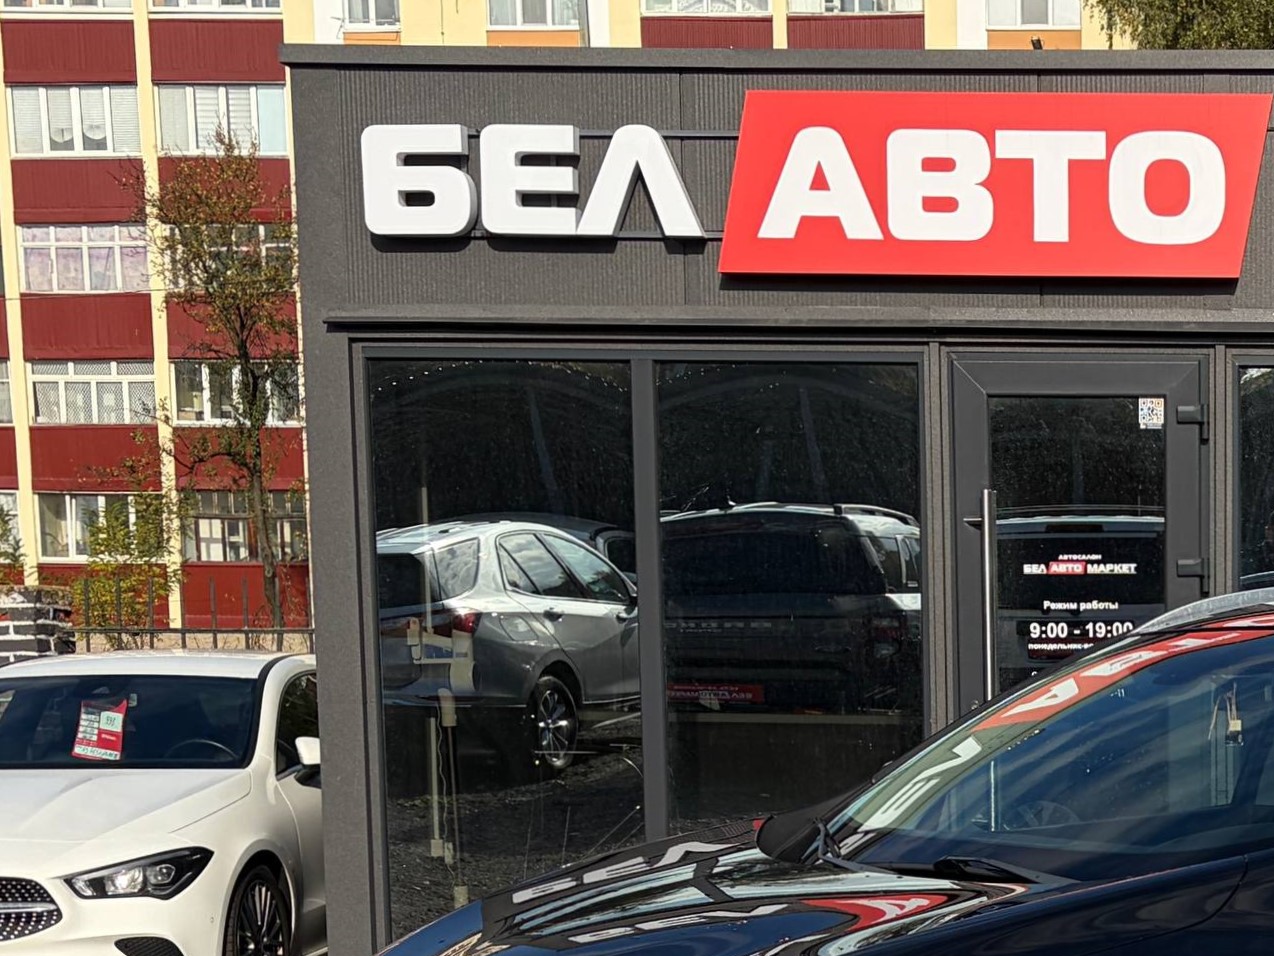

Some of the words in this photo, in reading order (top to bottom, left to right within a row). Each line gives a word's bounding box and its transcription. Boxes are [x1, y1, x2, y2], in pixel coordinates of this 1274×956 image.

[361, 123, 706, 238] БЕЛ
[757, 125, 1227, 245] АВТО
[1023, 563, 1047, 574] БЕЛ
[1050, 563, 1083, 573] АВТО
[1086, 563, 1138, 574] МАРКЕТ
[1043, 600, 1077, 610] Режим
[1079, 600, 1119, 611] работы
[1029, 622, 1068, 638] 9:00
